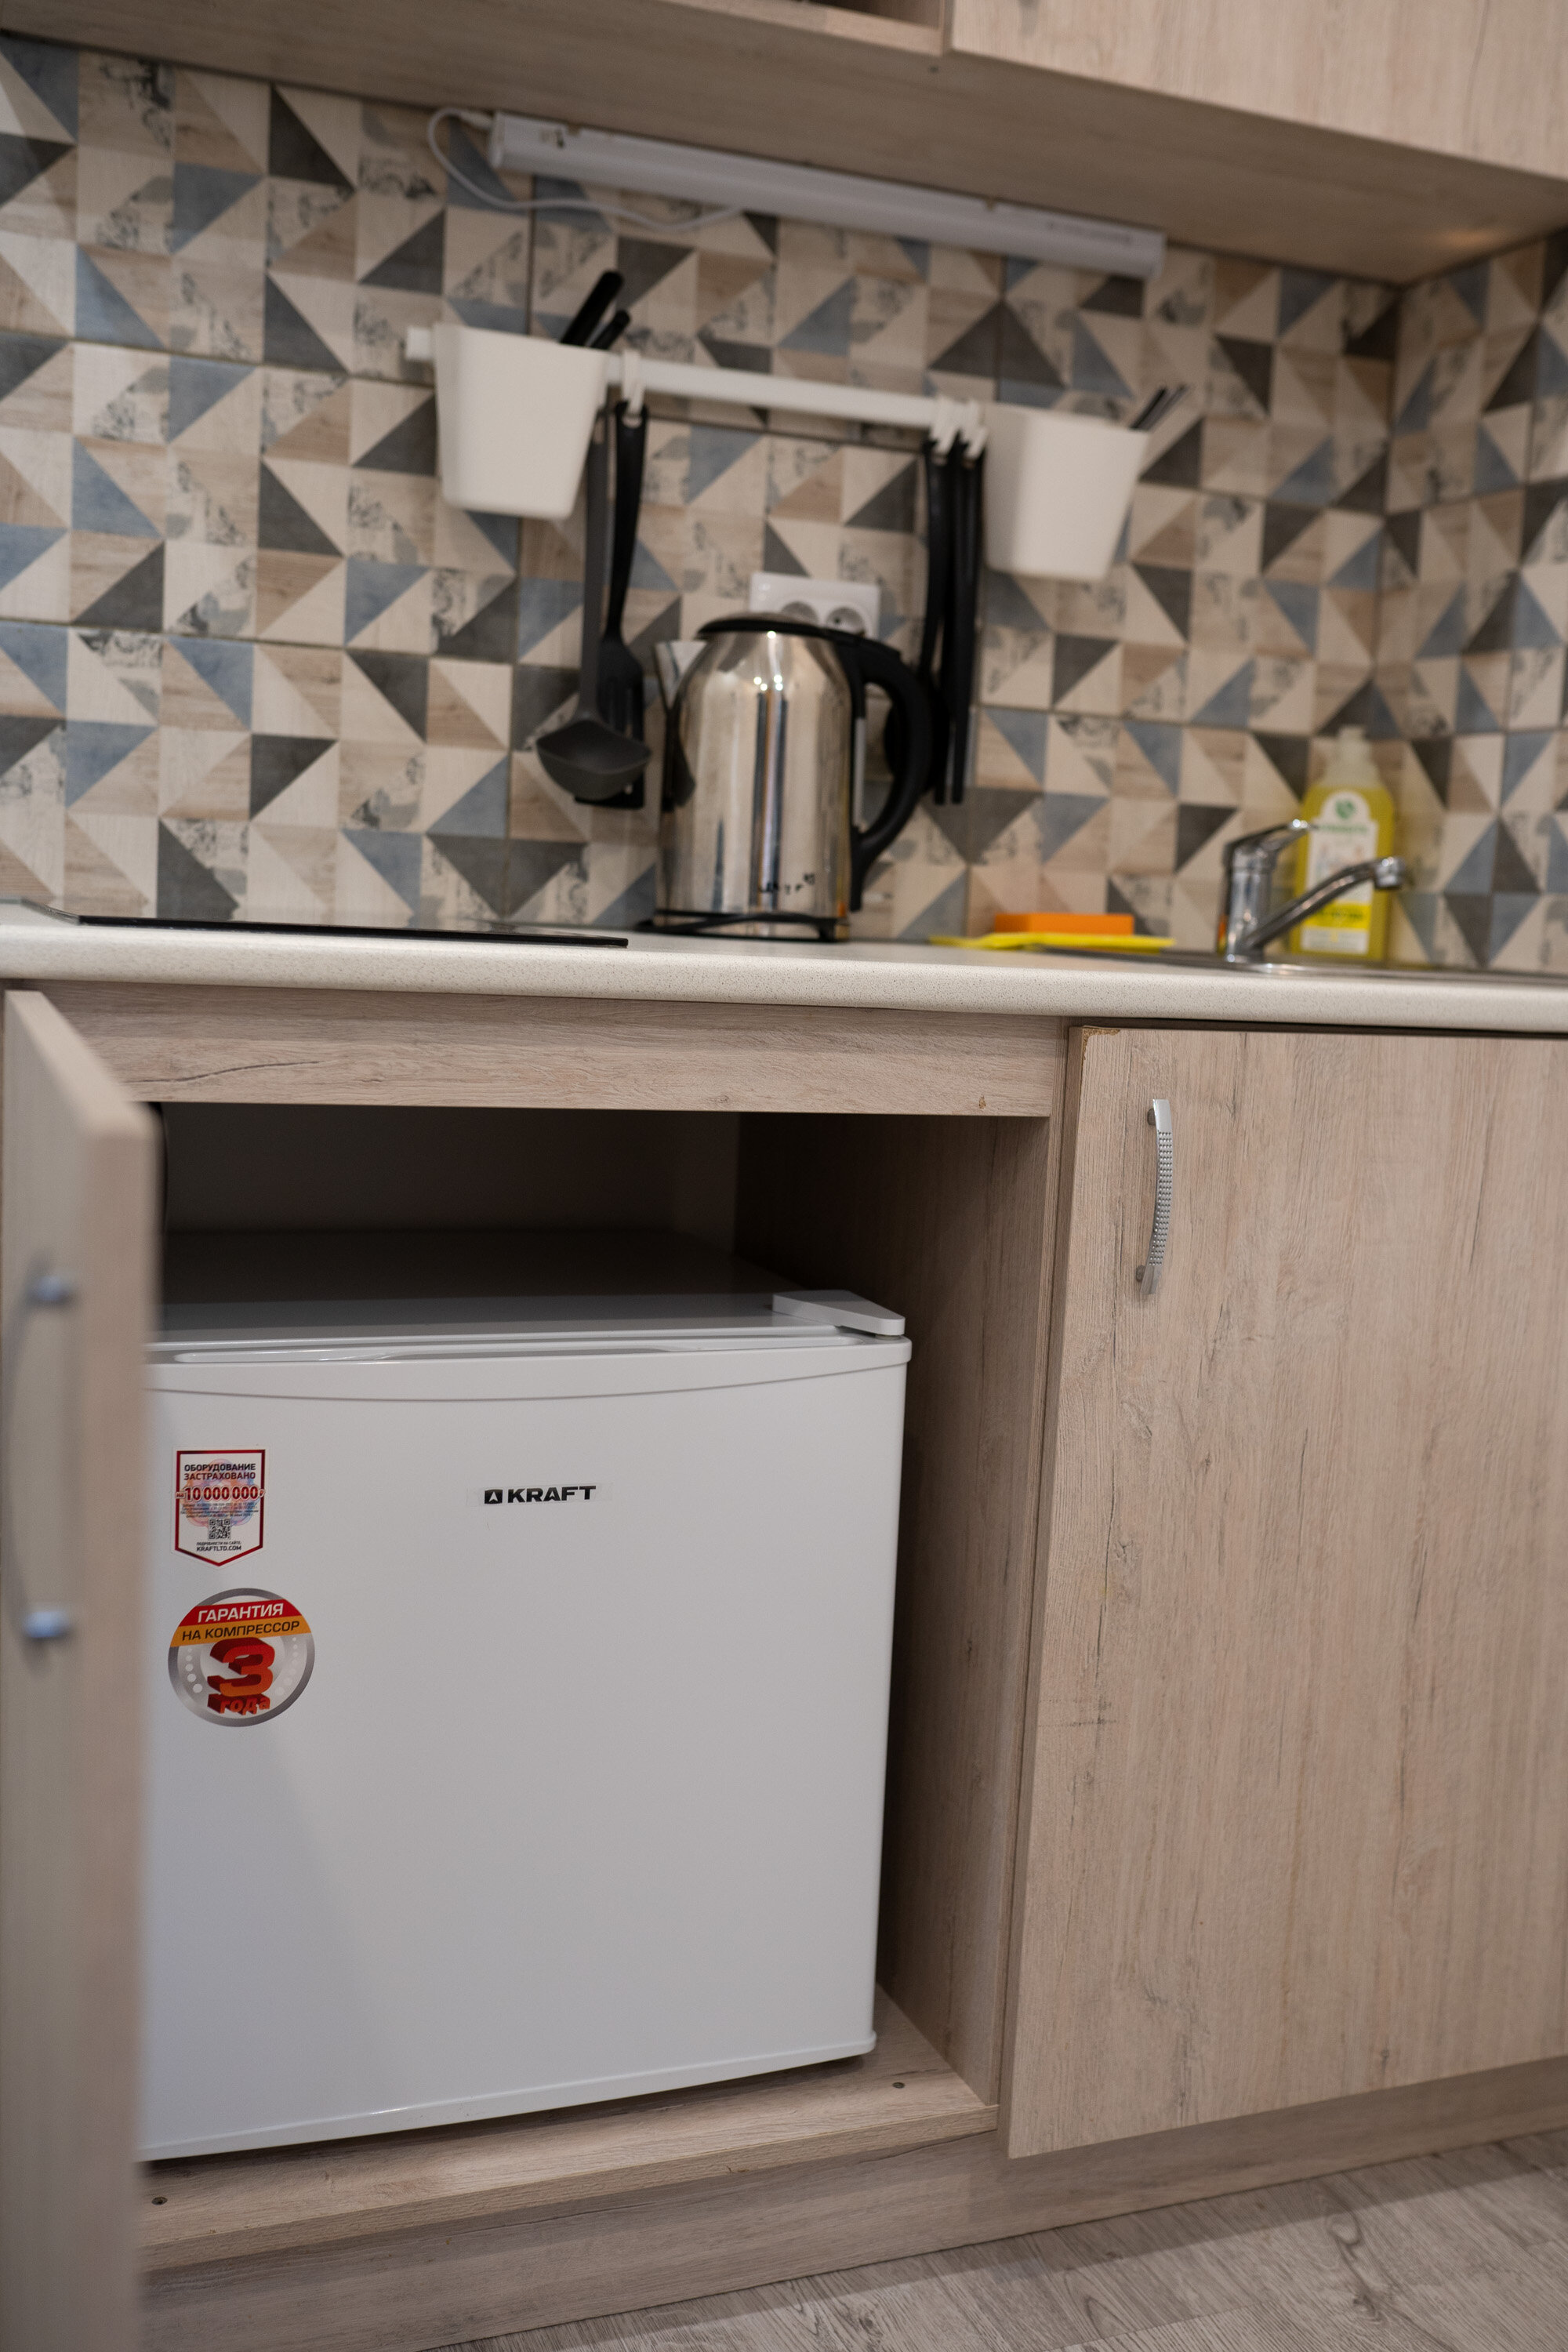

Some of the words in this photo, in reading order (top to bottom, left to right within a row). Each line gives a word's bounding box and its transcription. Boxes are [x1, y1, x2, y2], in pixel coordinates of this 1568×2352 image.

[184, 1463, 256, 1472] ОБОРУДОВАНИЕ
[184, 1472, 256, 1480] ЗАСТРАХОВАНО
[507, 1485, 597, 1504] KRAFT
[197, 1602, 285, 1624] ГАРАНТИЯ
[182, 1630, 201, 1641] НА
[205, 1621, 300, 1639] КОМПРЕССОР
[209, 1639, 275, 1697] 3
[212, 1695, 271, 1716] года
